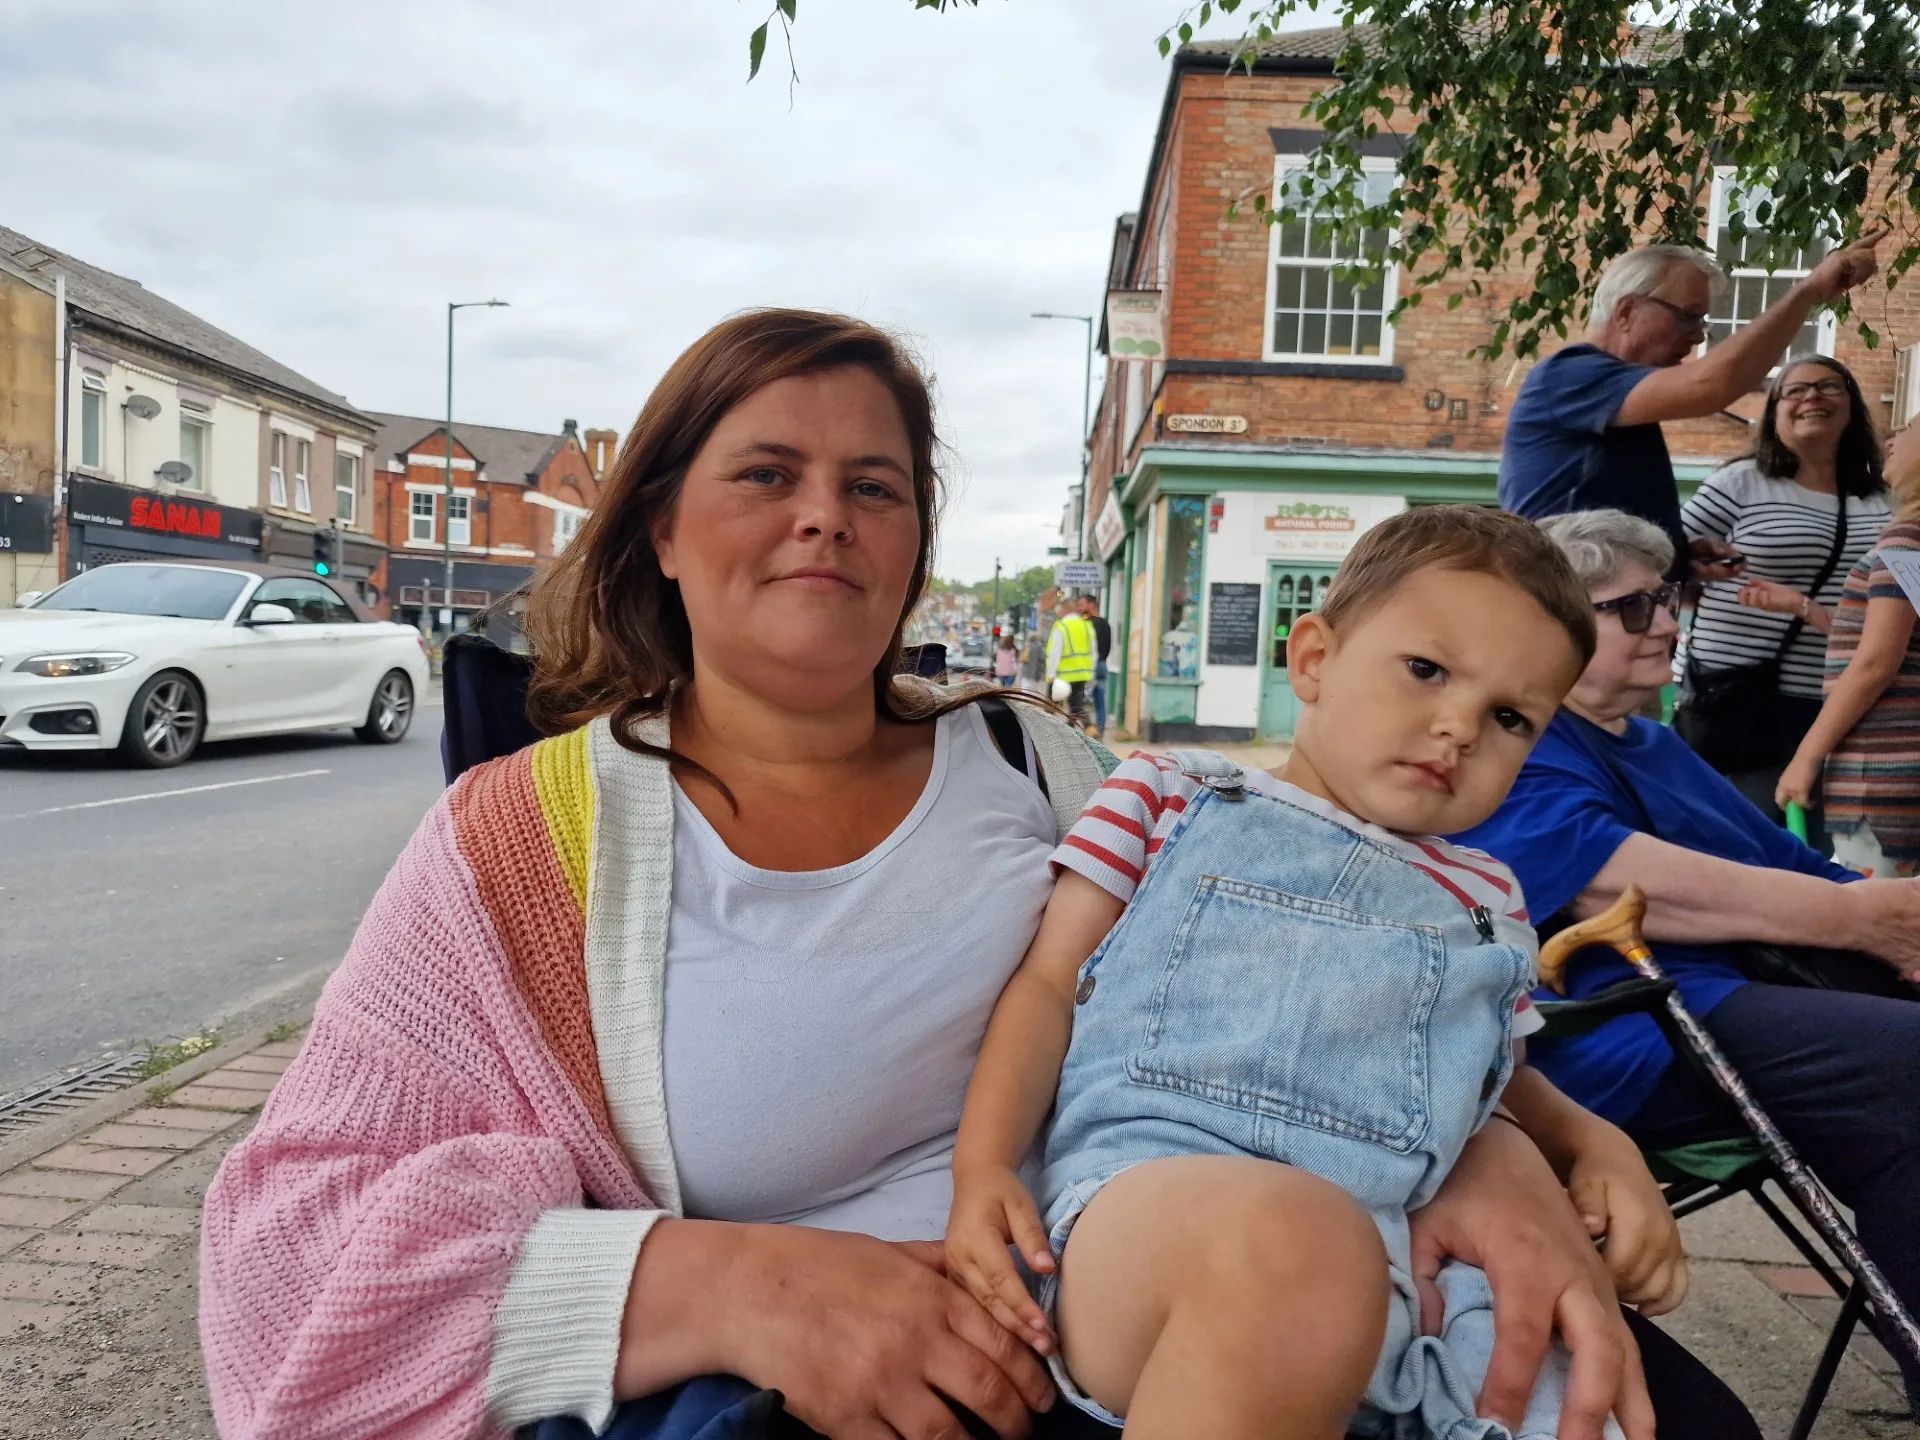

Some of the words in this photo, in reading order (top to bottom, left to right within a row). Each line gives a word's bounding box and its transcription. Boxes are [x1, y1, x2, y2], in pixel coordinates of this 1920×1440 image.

[1170, 418, 1224, 430] SPONDON
[1274, 519, 1318, 529] NATURAL
[1319, 520, 1350, 530] FOODS
[1891, 560, 1920, 591] FI
